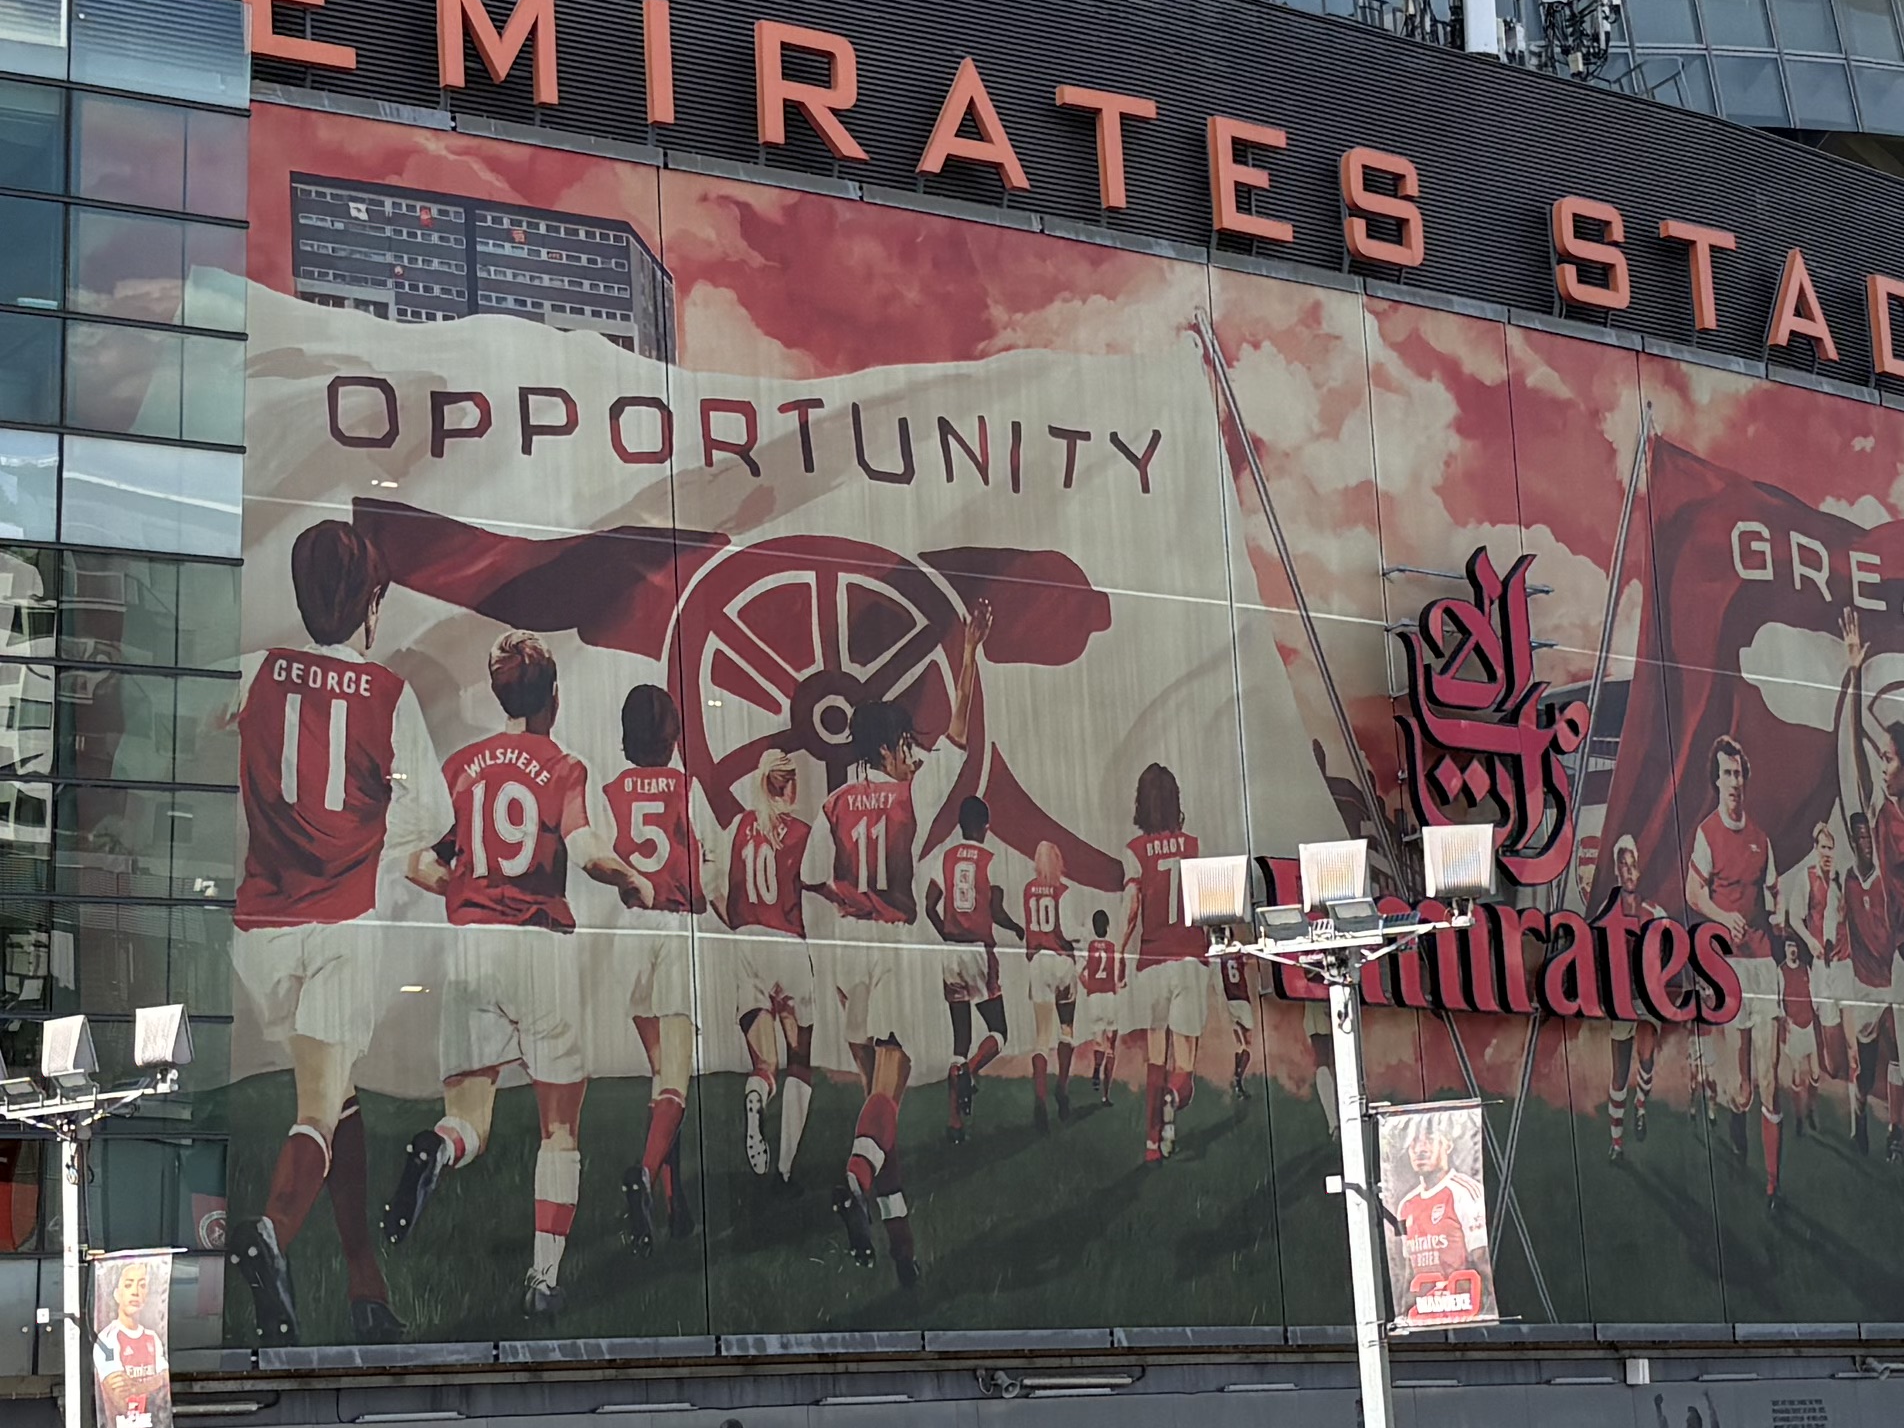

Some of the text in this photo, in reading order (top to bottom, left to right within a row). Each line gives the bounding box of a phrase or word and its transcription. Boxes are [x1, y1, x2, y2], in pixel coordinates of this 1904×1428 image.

[327, 375, 1162, 494] OPPORTUNITY
[273, 659, 372, 697] GEORGE
[281, 693, 347, 811] 11
[464, 748, 551, 786] WILSHERE
[624, 777, 676, 793] O'LEARY
[847, 792, 897, 811] YANKEY
[472, 780, 539, 879] 19
[629, 801, 671, 873] 5
[1146, 837, 1185, 856] BRADY
[742, 839, 778, 905] 10
[851, 815, 888, 893] 11
[954, 861, 976, 912] 8
[1029, 896, 1055, 932] 10
[1095, 950, 1107, 978] 2
[1227, 960, 1240, 984] 6
